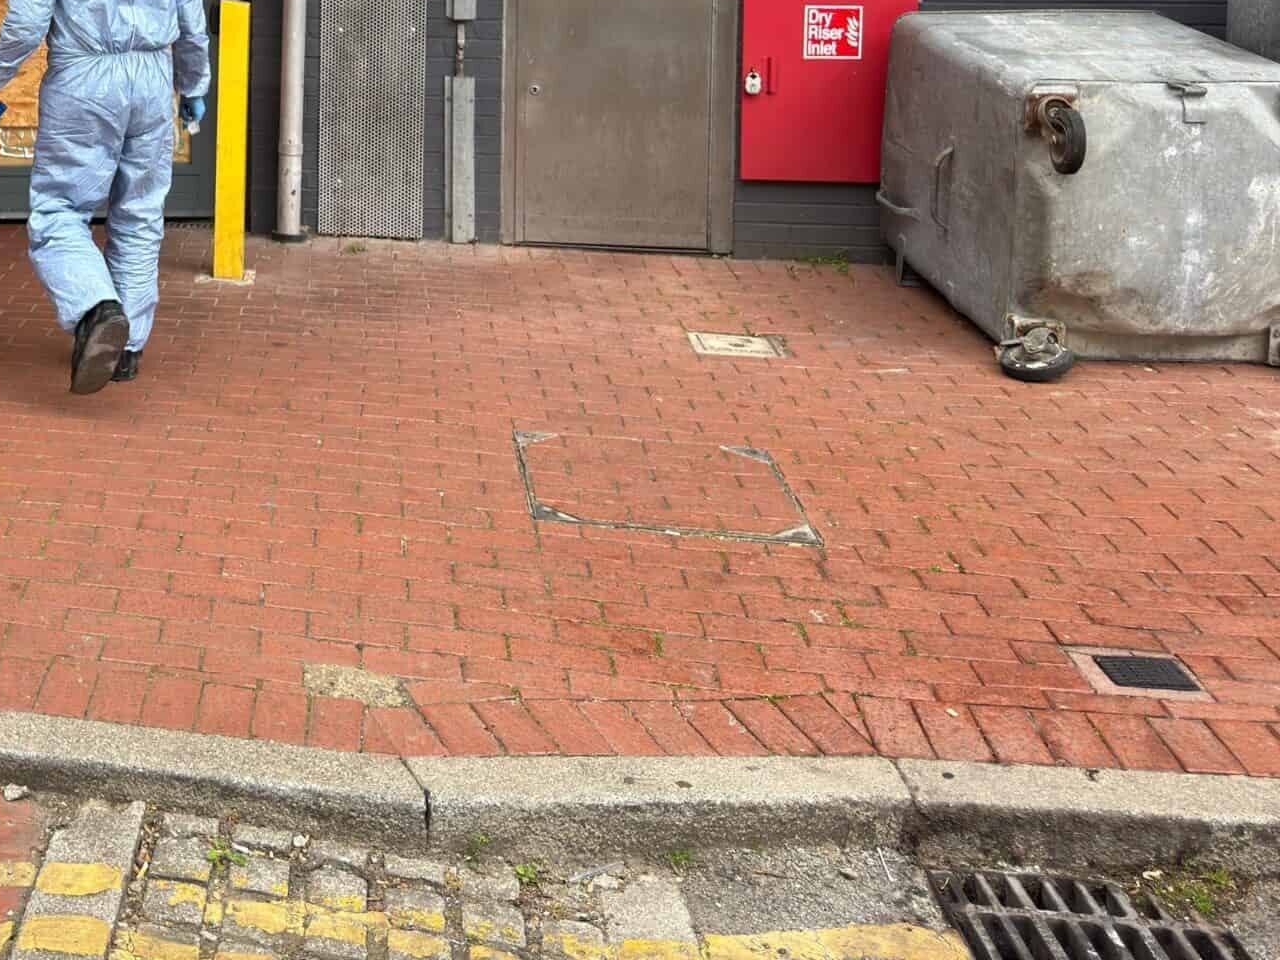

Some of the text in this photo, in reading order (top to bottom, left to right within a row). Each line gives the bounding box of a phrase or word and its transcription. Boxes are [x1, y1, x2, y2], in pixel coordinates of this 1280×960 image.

[808, 9, 832, 27] Dry
[808, 25, 844, 40] Riser
[807, 40, 837, 56] Inlet
